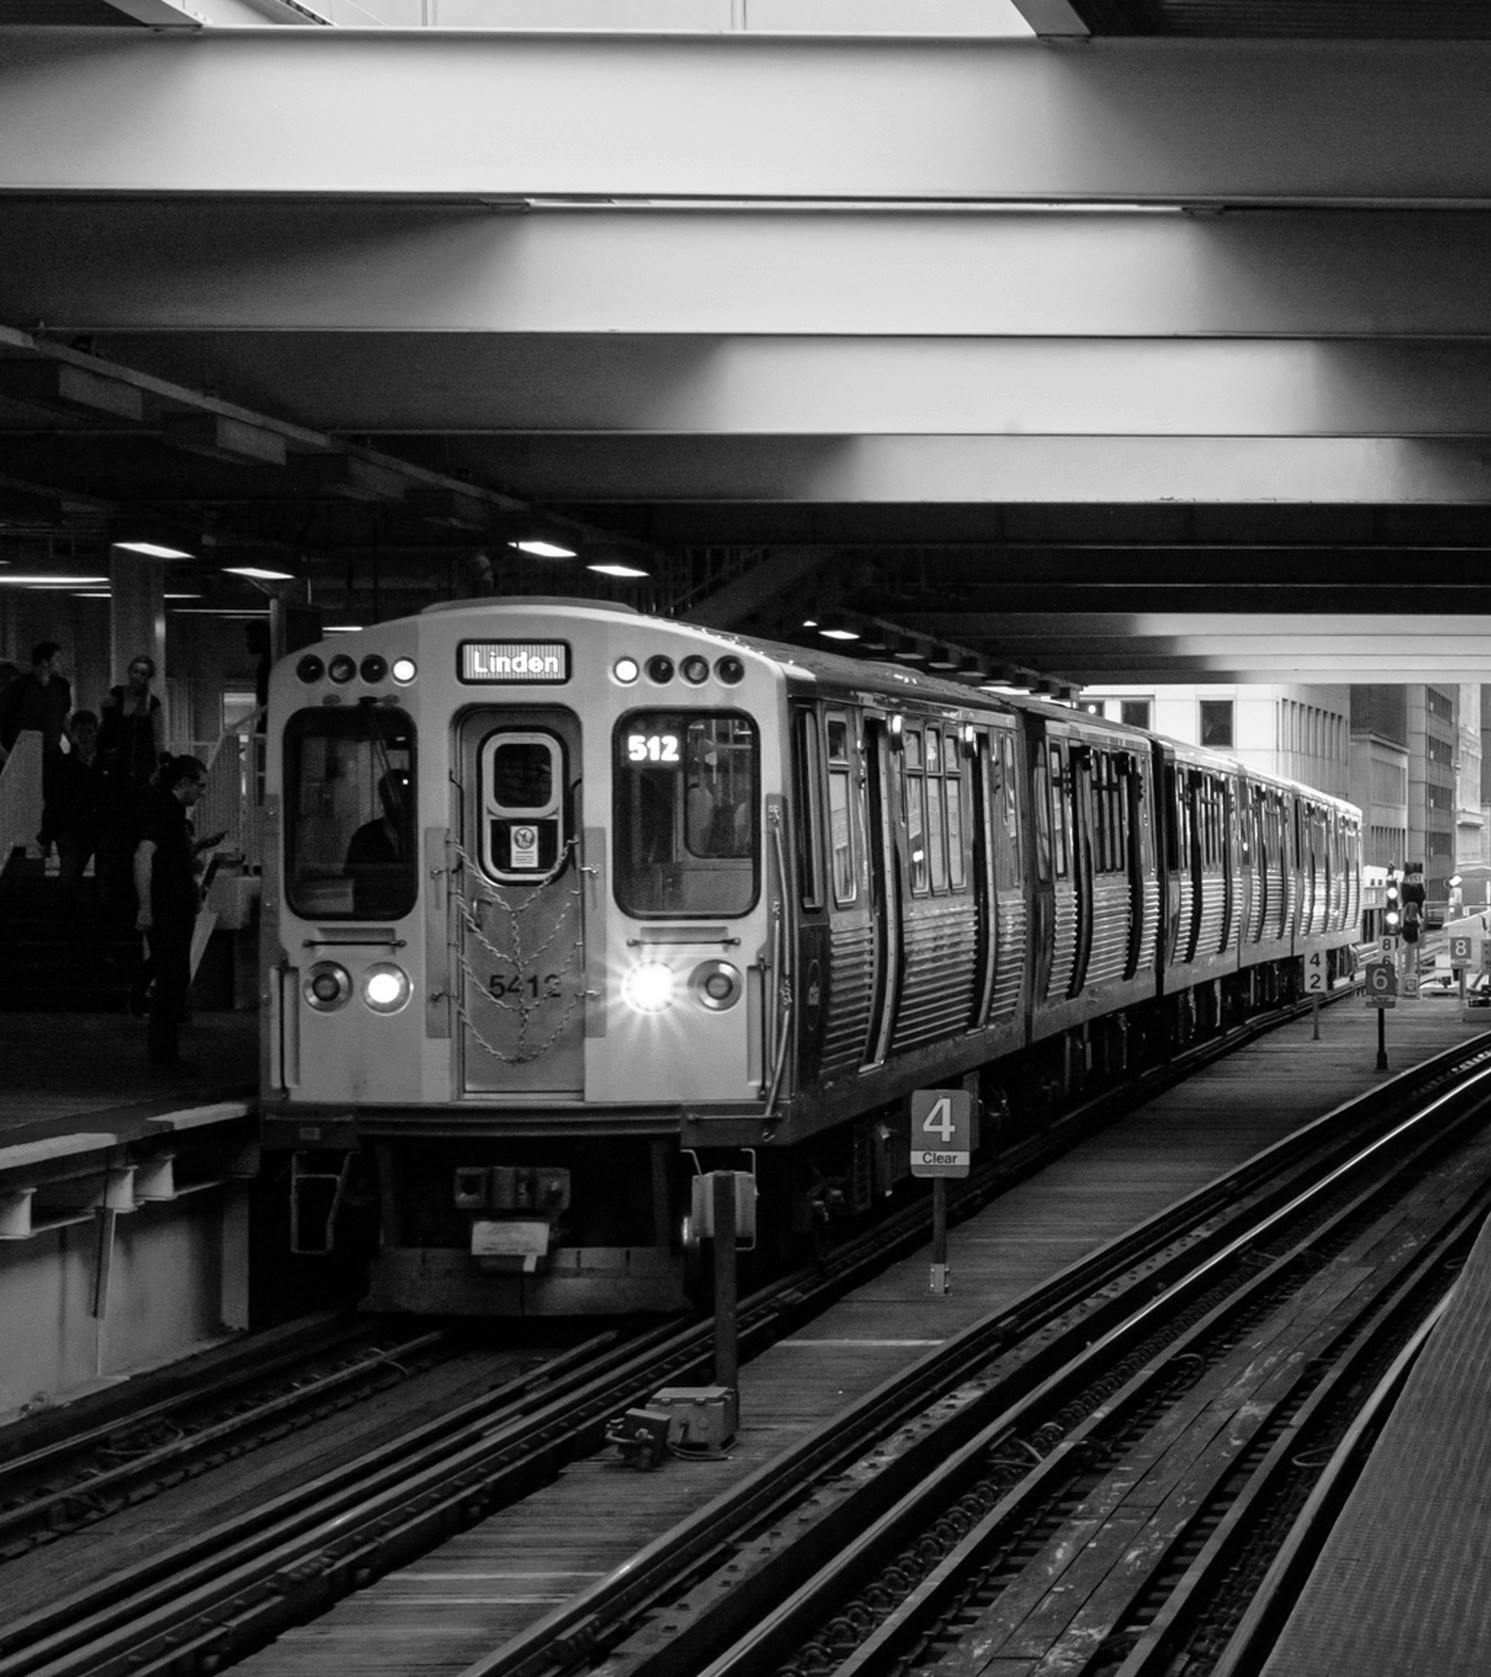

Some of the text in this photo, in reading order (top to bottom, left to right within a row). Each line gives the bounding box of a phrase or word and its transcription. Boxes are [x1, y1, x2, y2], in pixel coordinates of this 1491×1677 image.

[473, 650, 560, 674] Linden
[627, 735, 680, 762] 512
[1382, 938, 1391, 951] 8
[1455, 939, 1467, 956] 8
[1309, 952, 1321, 967] 4
[1309, 973, 1321, 989] 2
[1372, 967, 1389, 990] 6
[922, 1097, 957, 1143] 4
[922, 1152, 958, 1164] Clear
